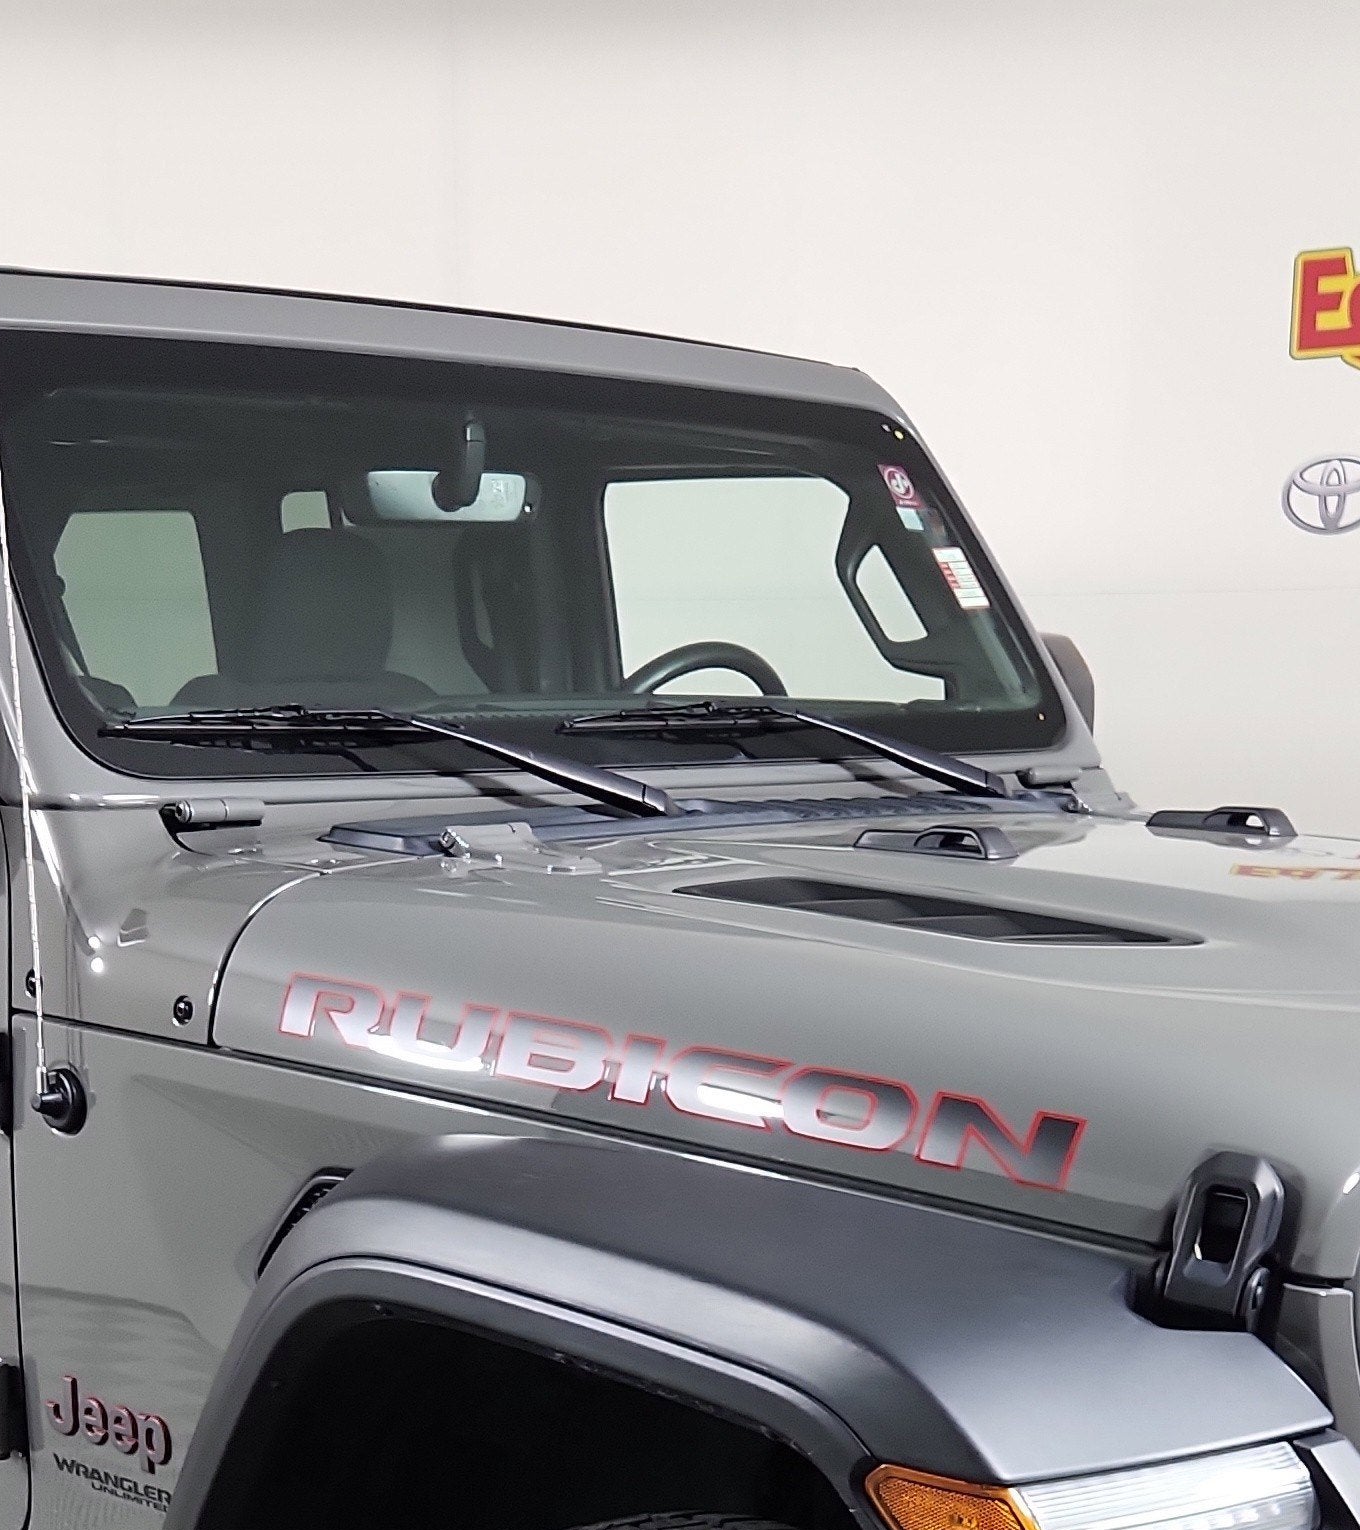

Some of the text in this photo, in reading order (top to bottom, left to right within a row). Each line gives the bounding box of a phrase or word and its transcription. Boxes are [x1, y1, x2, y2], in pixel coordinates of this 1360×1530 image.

[279, 972, 1087, 1191] RUBICON
[47, 1375, 172, 1475] Jeep
[52, 1452, 173, 1506] WRANGLER
